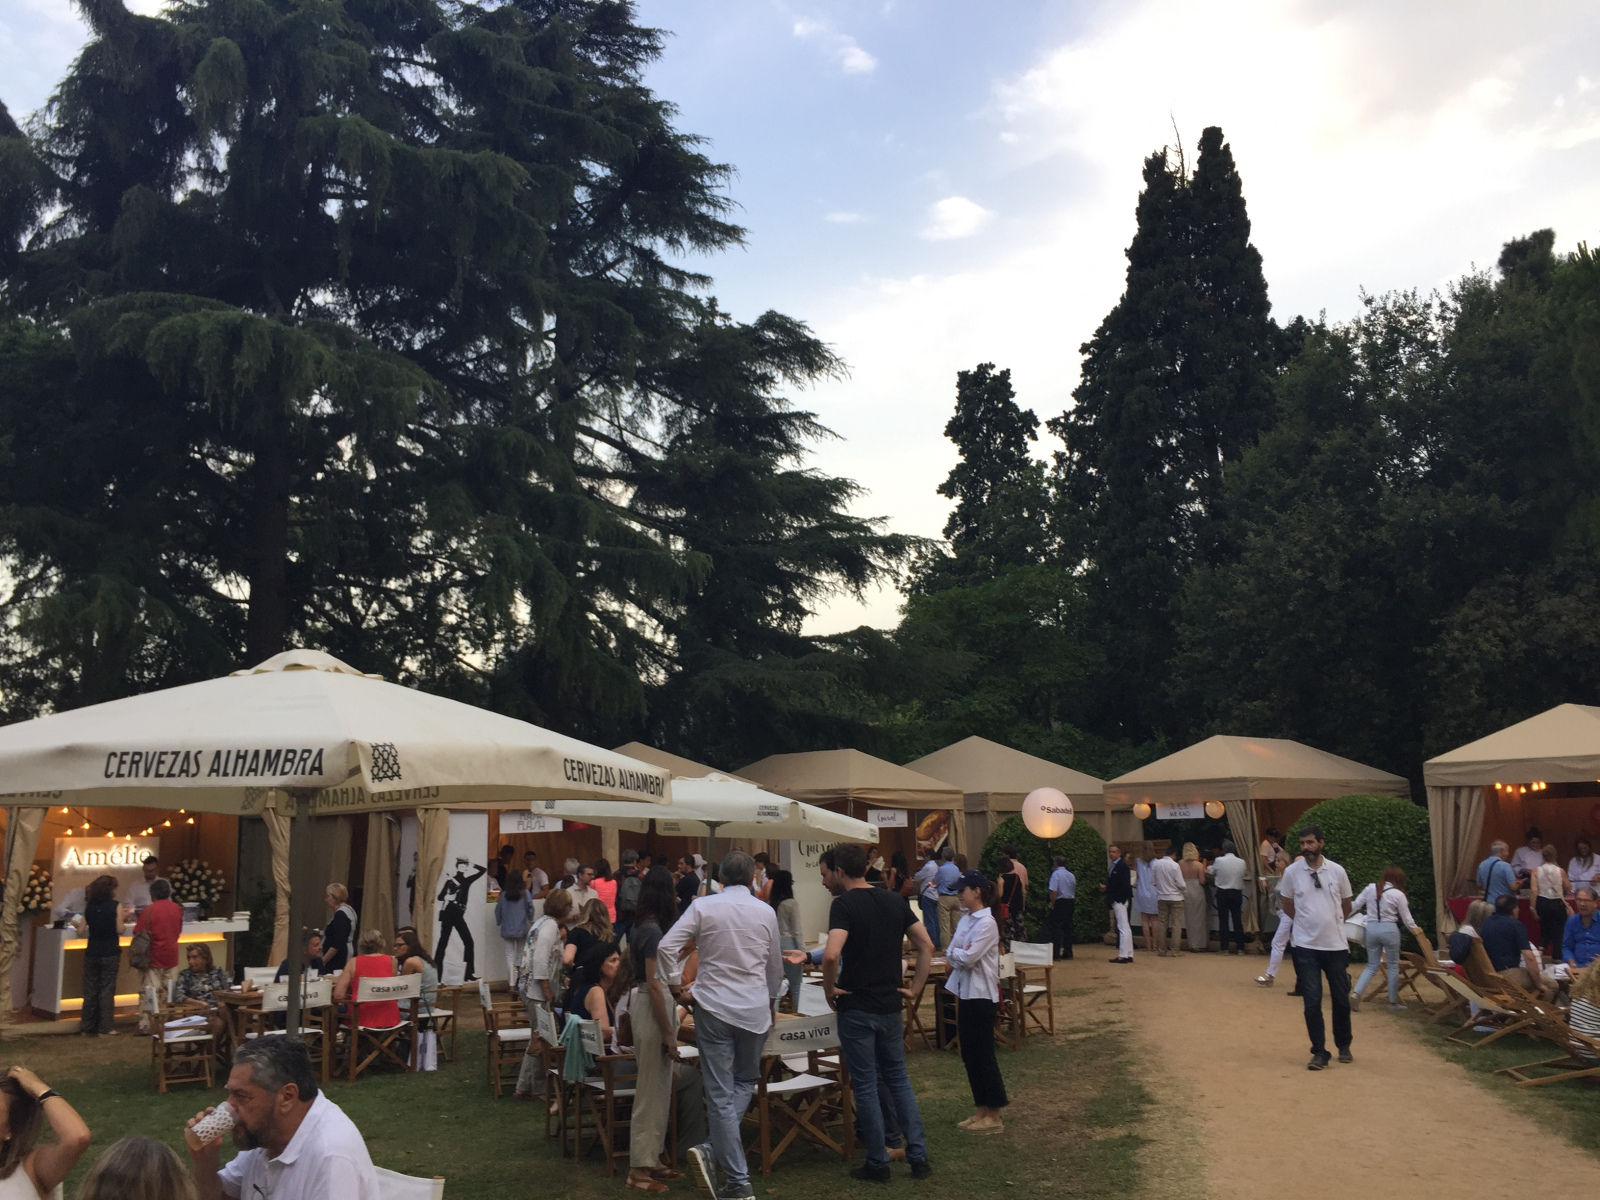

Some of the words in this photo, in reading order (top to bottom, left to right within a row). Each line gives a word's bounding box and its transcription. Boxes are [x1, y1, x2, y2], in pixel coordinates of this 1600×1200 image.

[104, 750, 203, 779] CERVEZAS
[207, 748, 325, 778] ALHAMBRA
[563, 757, 616, 788] CERVEZAS
[618, 768, 665, 798] ALHAMBRA
[61, 844, 153, 868] Amélie
[392, 984, 409, 992] viva
[780, 1031, 806, 1041] casa
[808, 1026, 831, 1039] viva
